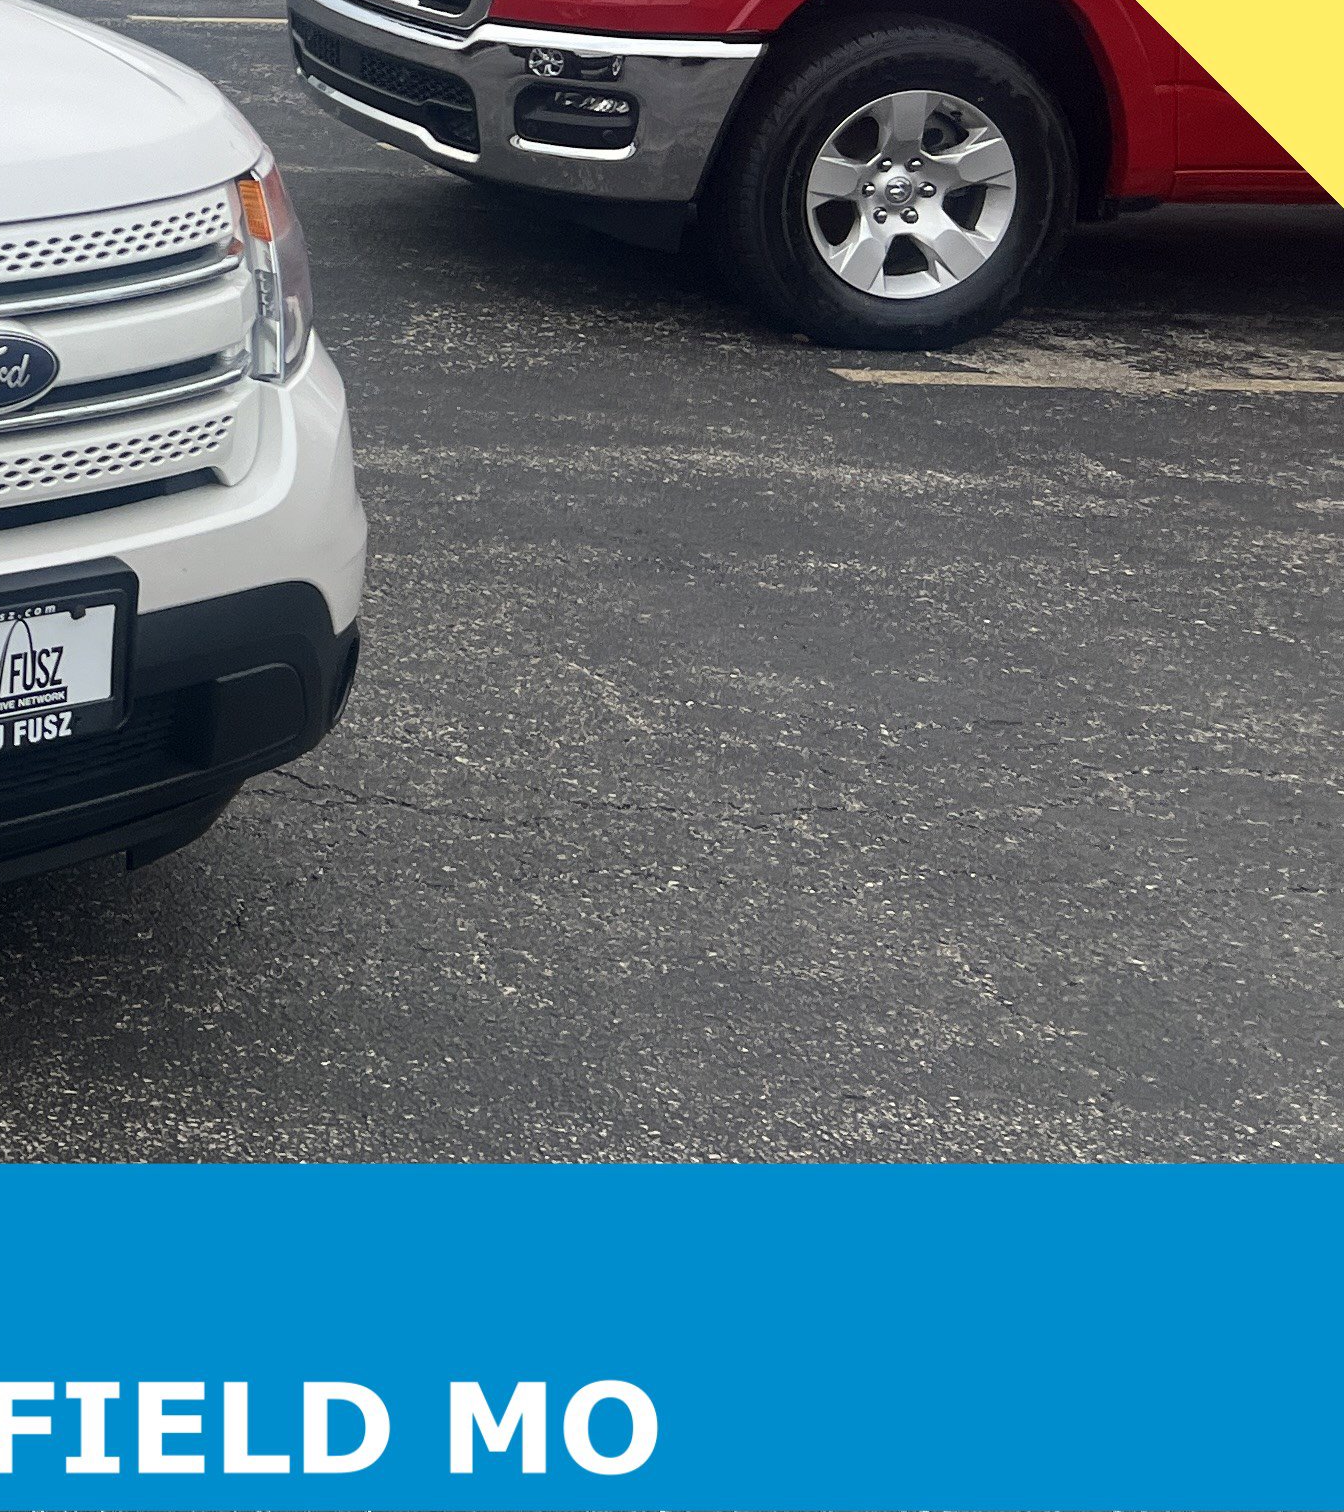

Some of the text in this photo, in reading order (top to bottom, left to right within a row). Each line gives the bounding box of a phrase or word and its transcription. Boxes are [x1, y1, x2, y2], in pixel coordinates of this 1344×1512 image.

[9, 646, 63, 694] FUSZ
[17, 690, 65, 708] NETWORK
[13, 710, 72, 747] FUSZ
